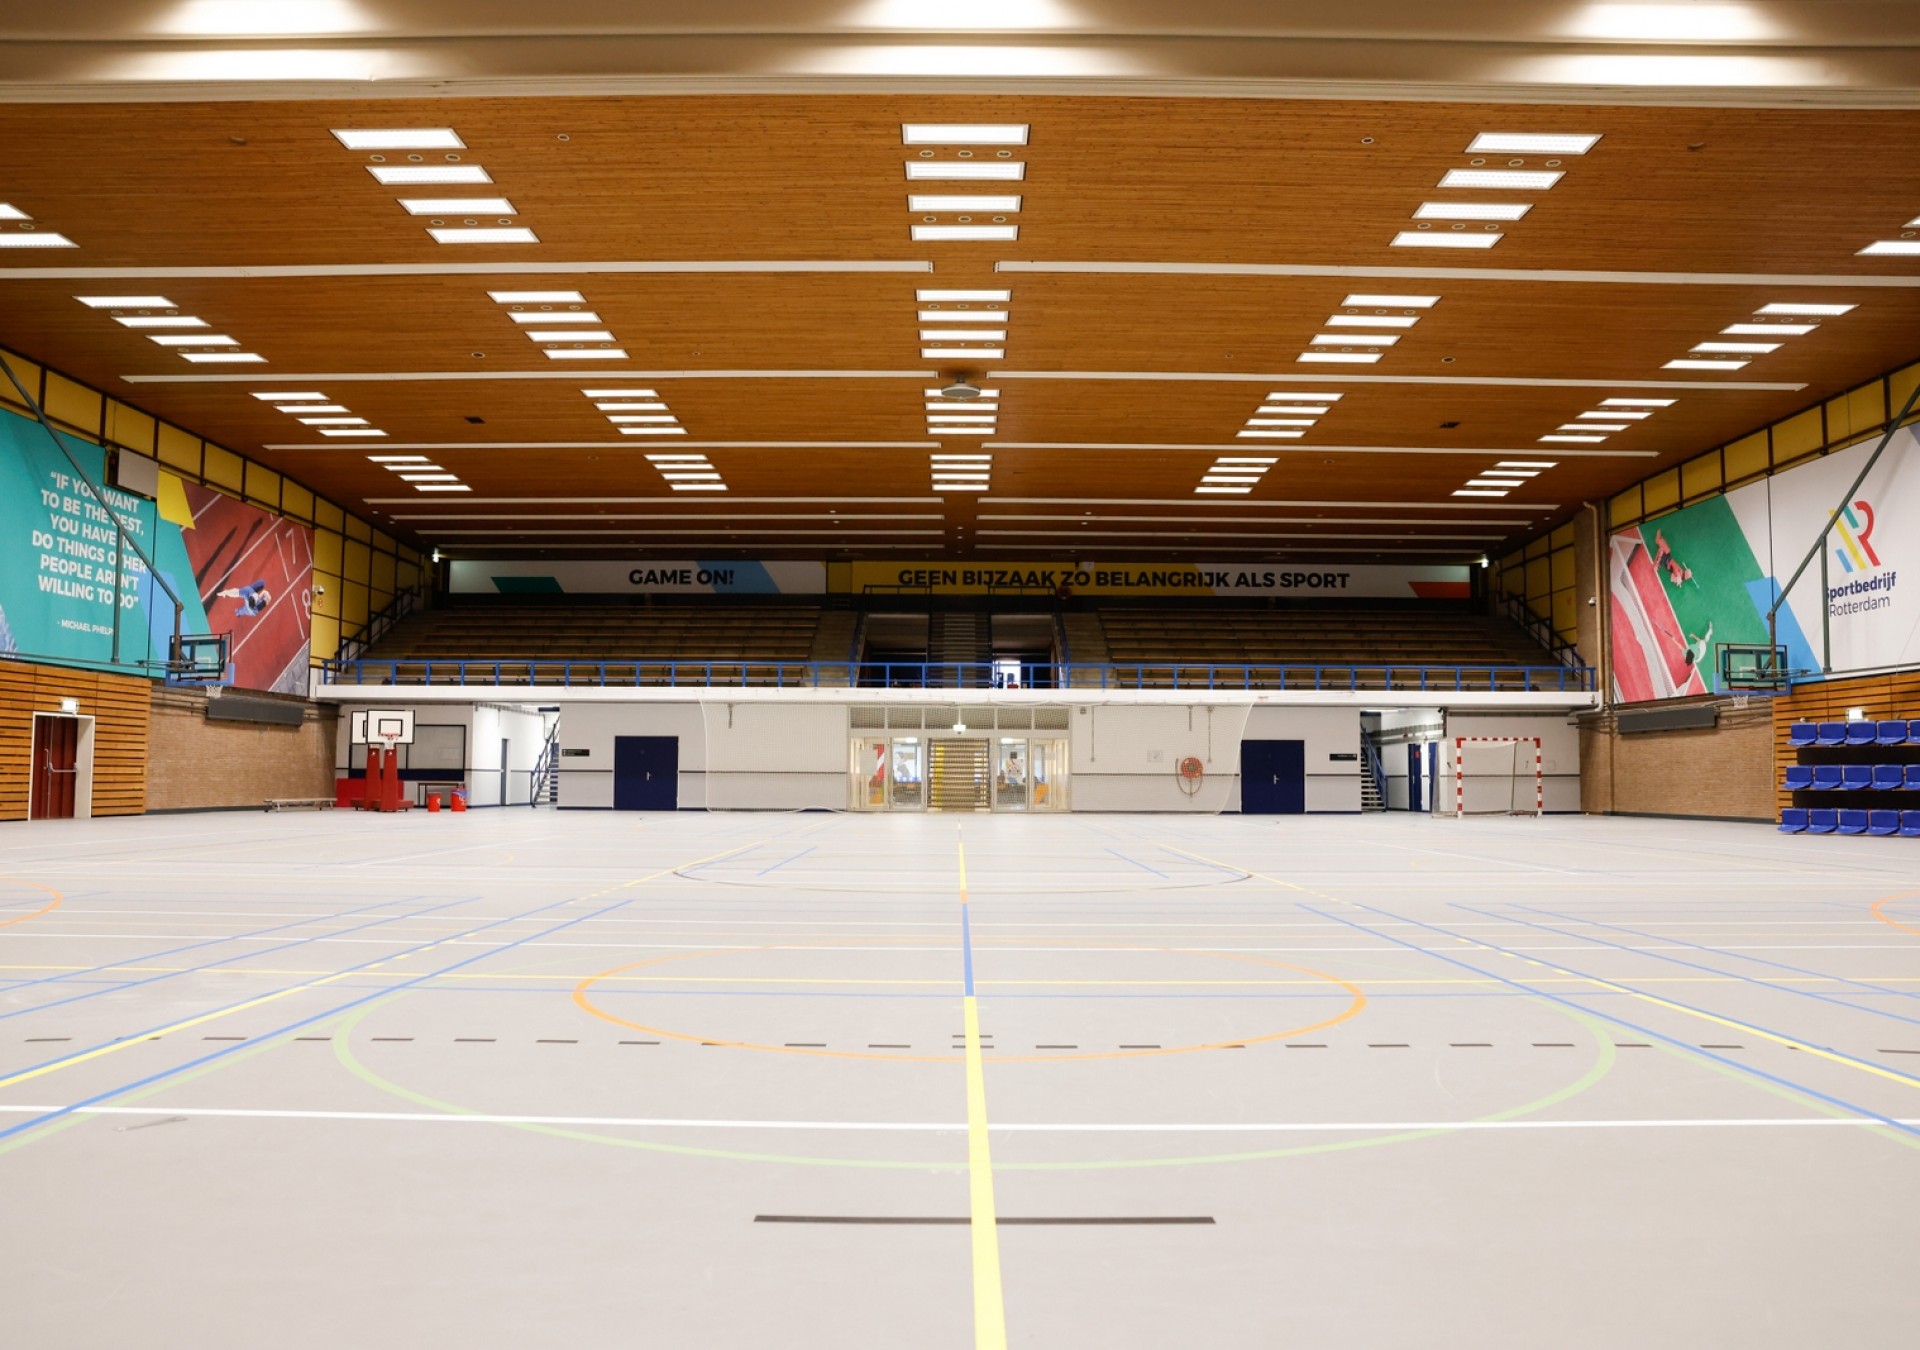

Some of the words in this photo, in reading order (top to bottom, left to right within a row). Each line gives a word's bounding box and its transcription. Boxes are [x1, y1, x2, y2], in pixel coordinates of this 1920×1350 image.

[41, 489, 59, 508] TO
[63, 496, 81, 516] BE
[84, 503, 109, 525] THE
[104, 488, 139, 513] WANT
[50, 513, 79, 535] YOU
[82, 523, 116, 546] HAVE
[32, 530, 53, 549] DO
[57, 536, 105, 563] THINGS
[108, 550, 147, 574] OHER
[40, 554, 93, 580] PEOPLE
[629, 569, 692, 585] GAME
[697, 569, 734, 585] ON!
[898, 570, 957, 586] GEEN
[962, 570, 1056, 586] BIJZAAK
[1060, 571, 1090, 587] ZO
[1095, 571, 1230, 587] BELANGRIJK
[1235, 572, 1275, 587] ALS
[1280, 573, 1350, 588] SPORT
[38, 575, 94, 601] WILLING
[97, 588, 114, 605] TO
[1829, 596, 1891, 618] Rotterdam
[61, 619, 91, 632] MICHAEL
[92, 624, 114, 636] PHELP
